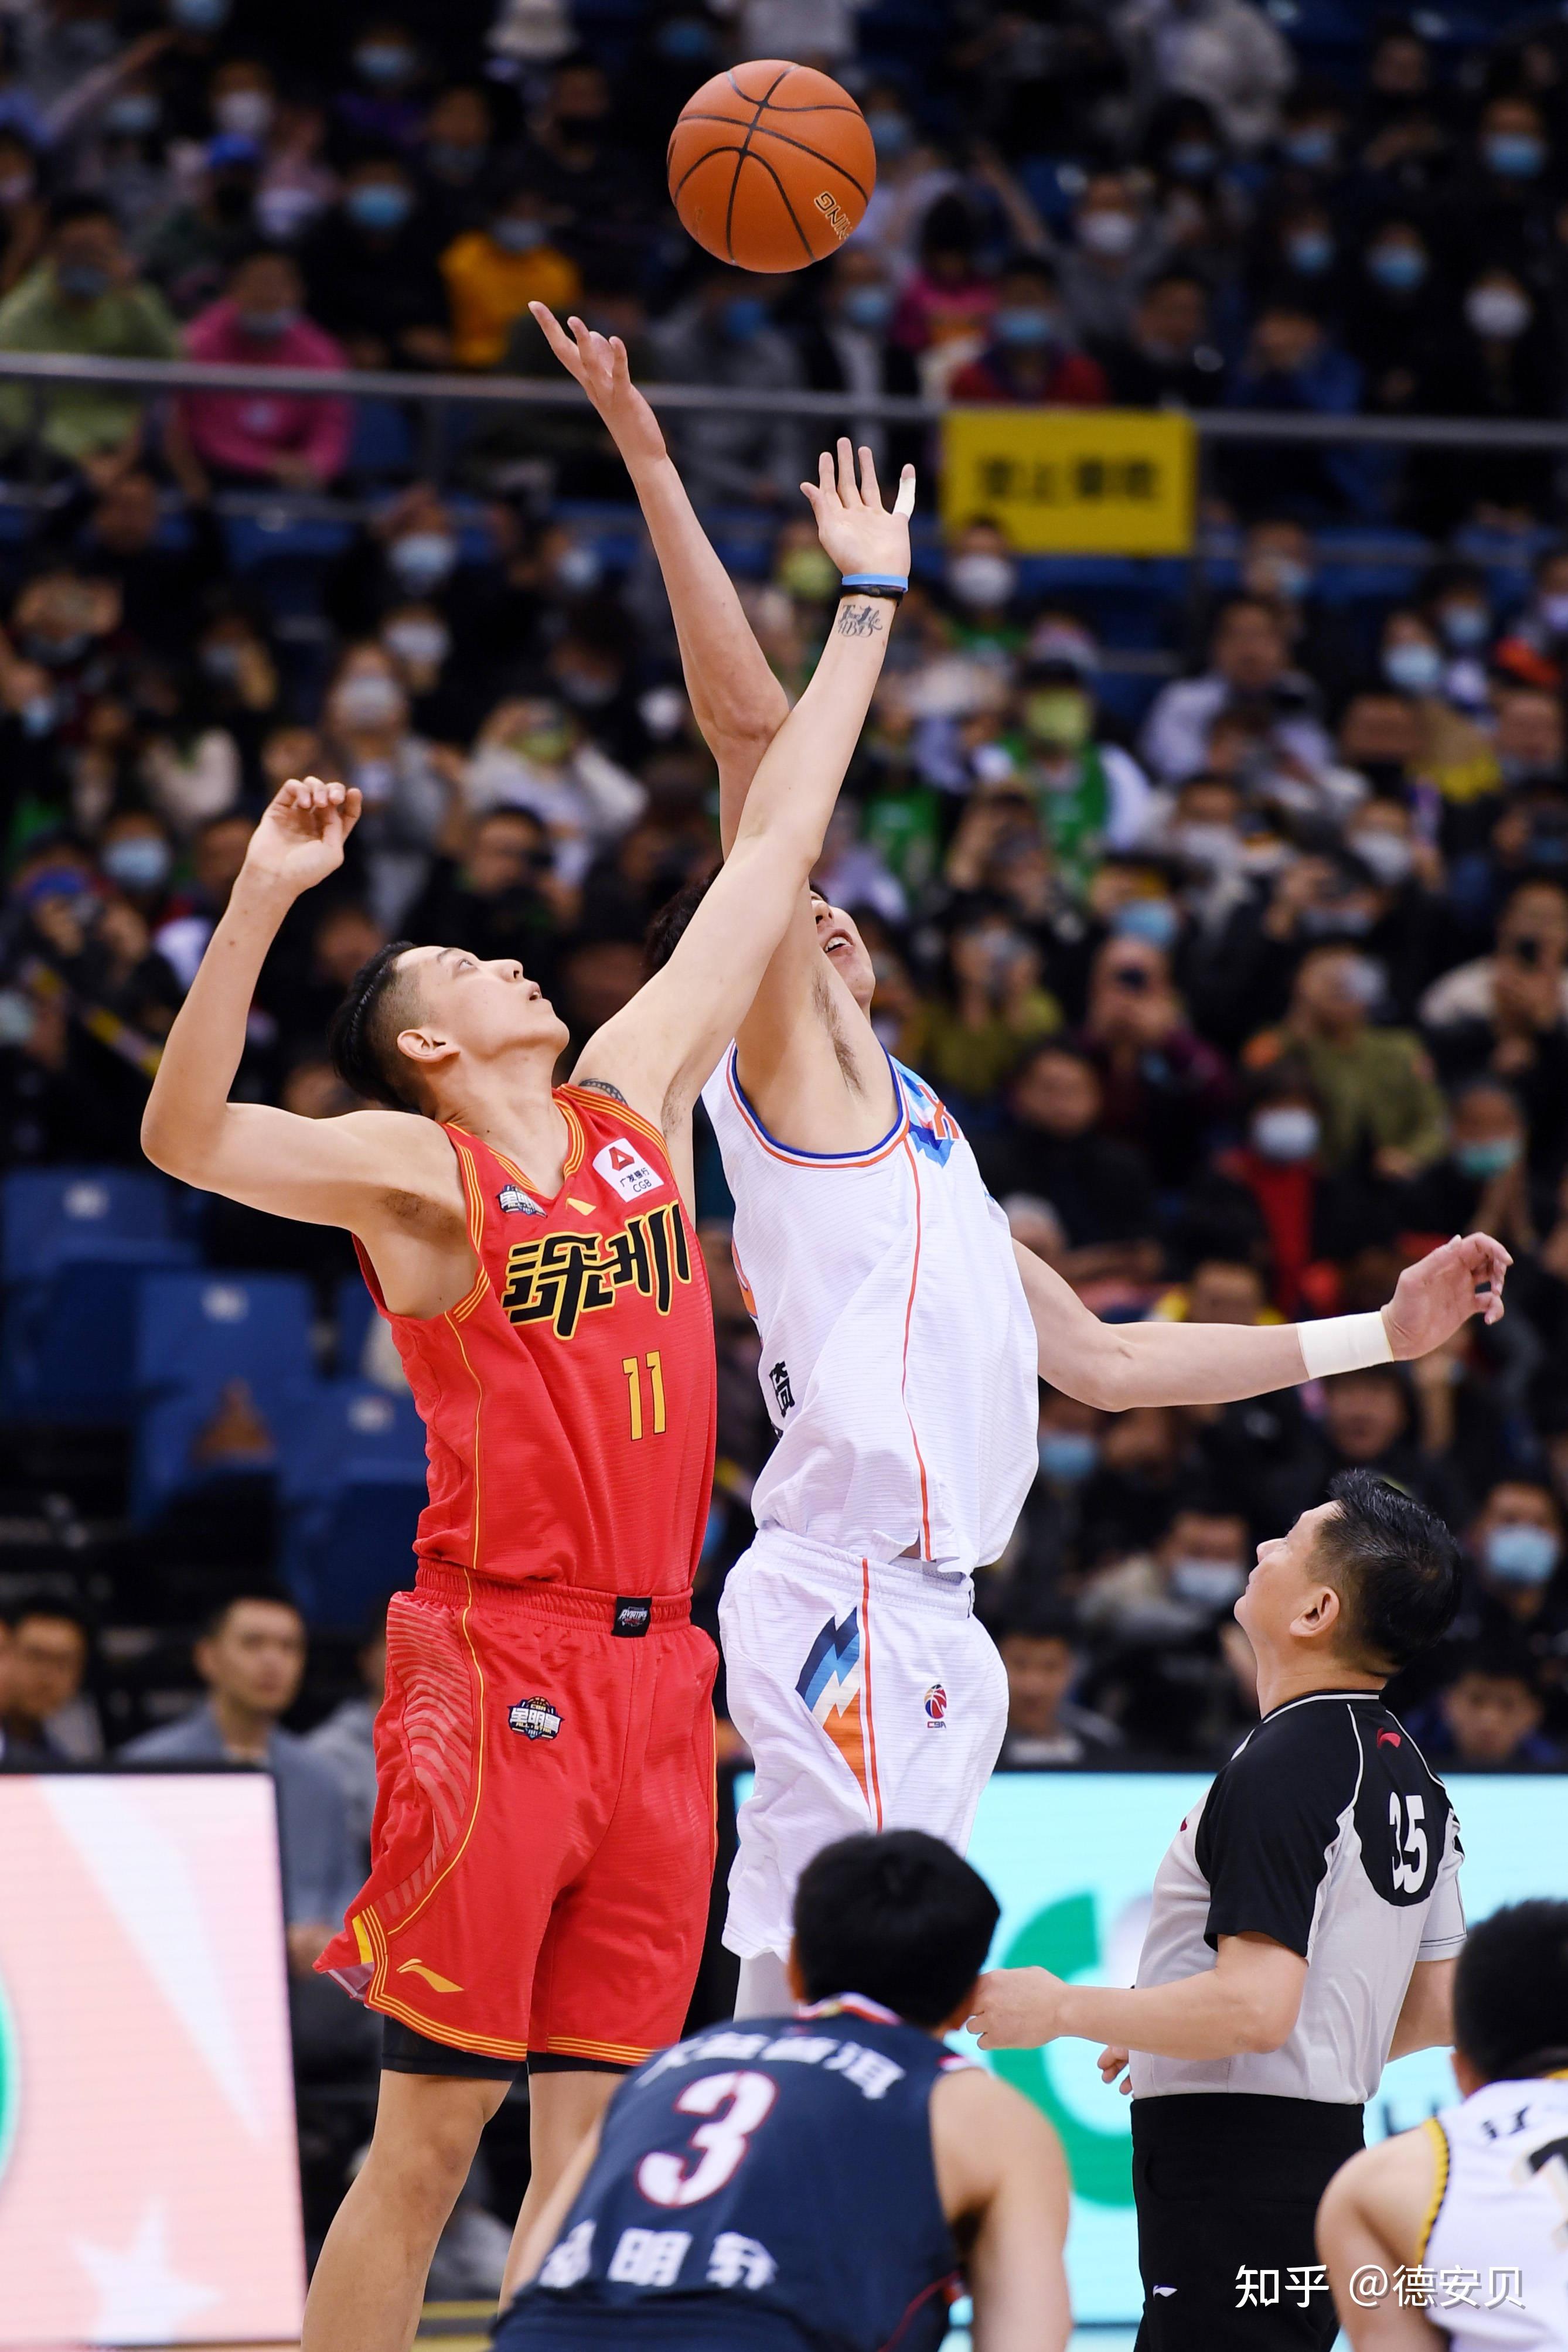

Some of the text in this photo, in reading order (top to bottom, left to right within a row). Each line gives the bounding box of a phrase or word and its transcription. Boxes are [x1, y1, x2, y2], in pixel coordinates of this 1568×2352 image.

[633, 1179, 652, 1192] CGB
[621, 1349, 667, 1441] 11
[927, 1721, 947, 1729] CBA
[1388, 1791, 1429, 1894] 35
[636, 2070, 780, 2209] 3
